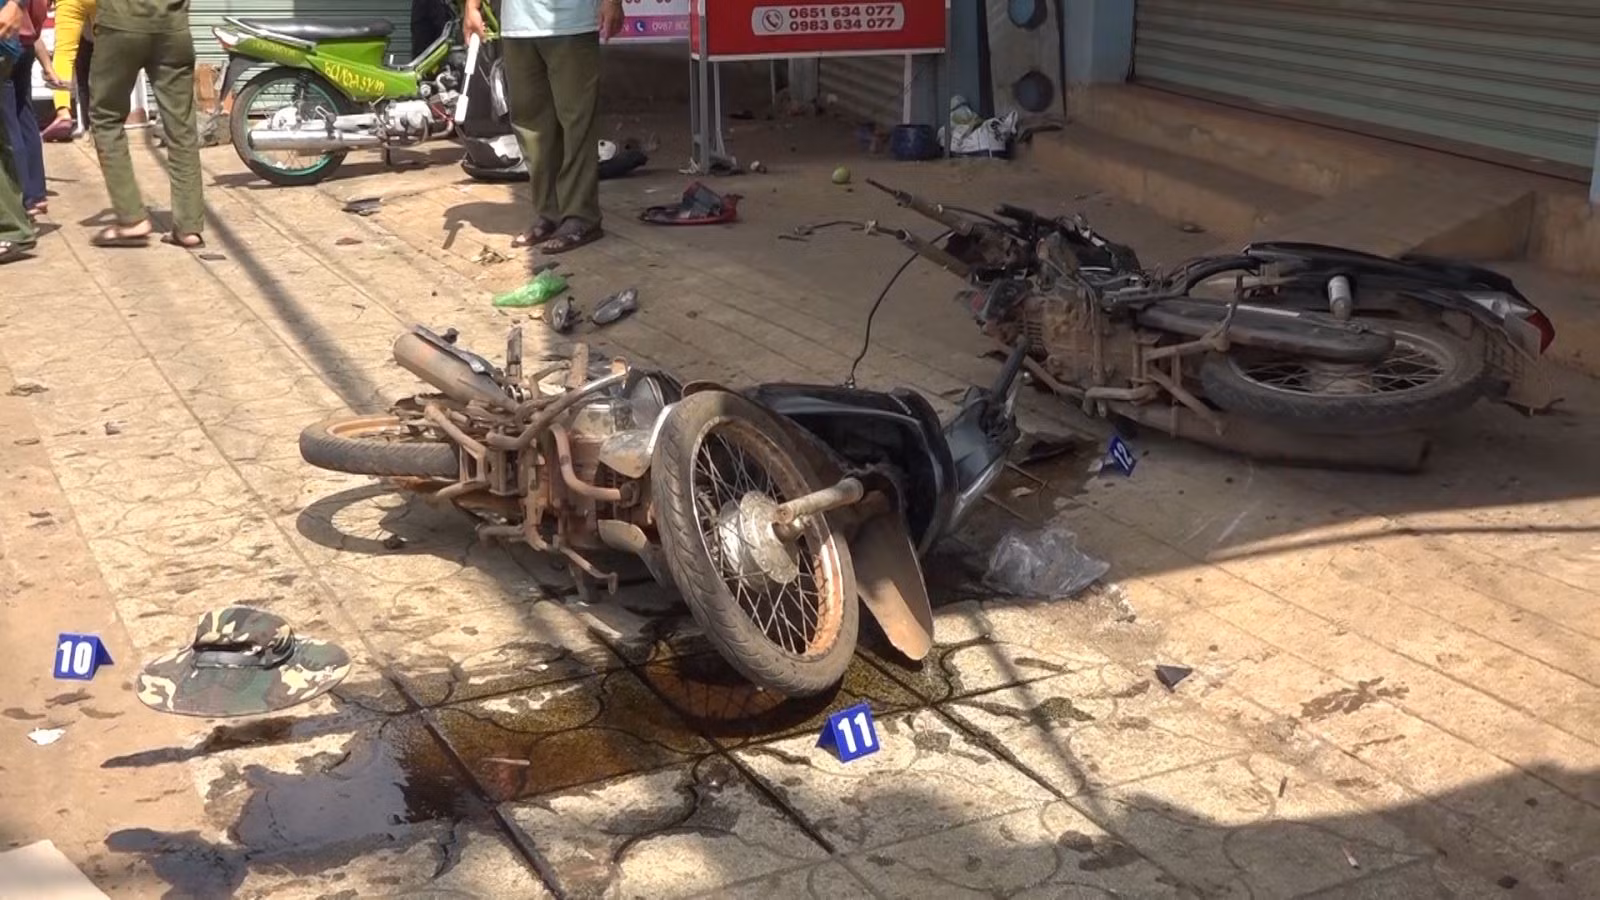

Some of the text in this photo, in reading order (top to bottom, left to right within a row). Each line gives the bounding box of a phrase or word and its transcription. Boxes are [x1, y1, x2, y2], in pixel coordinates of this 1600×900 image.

[788, 5, 895, 18] 0651 634 077
[789, 18, 895, 31] 0983 634 077
[1113, 441, 1133, 470] 12
[60, 640, 93, 676] 10
[837, 712, 873, 753] 11
